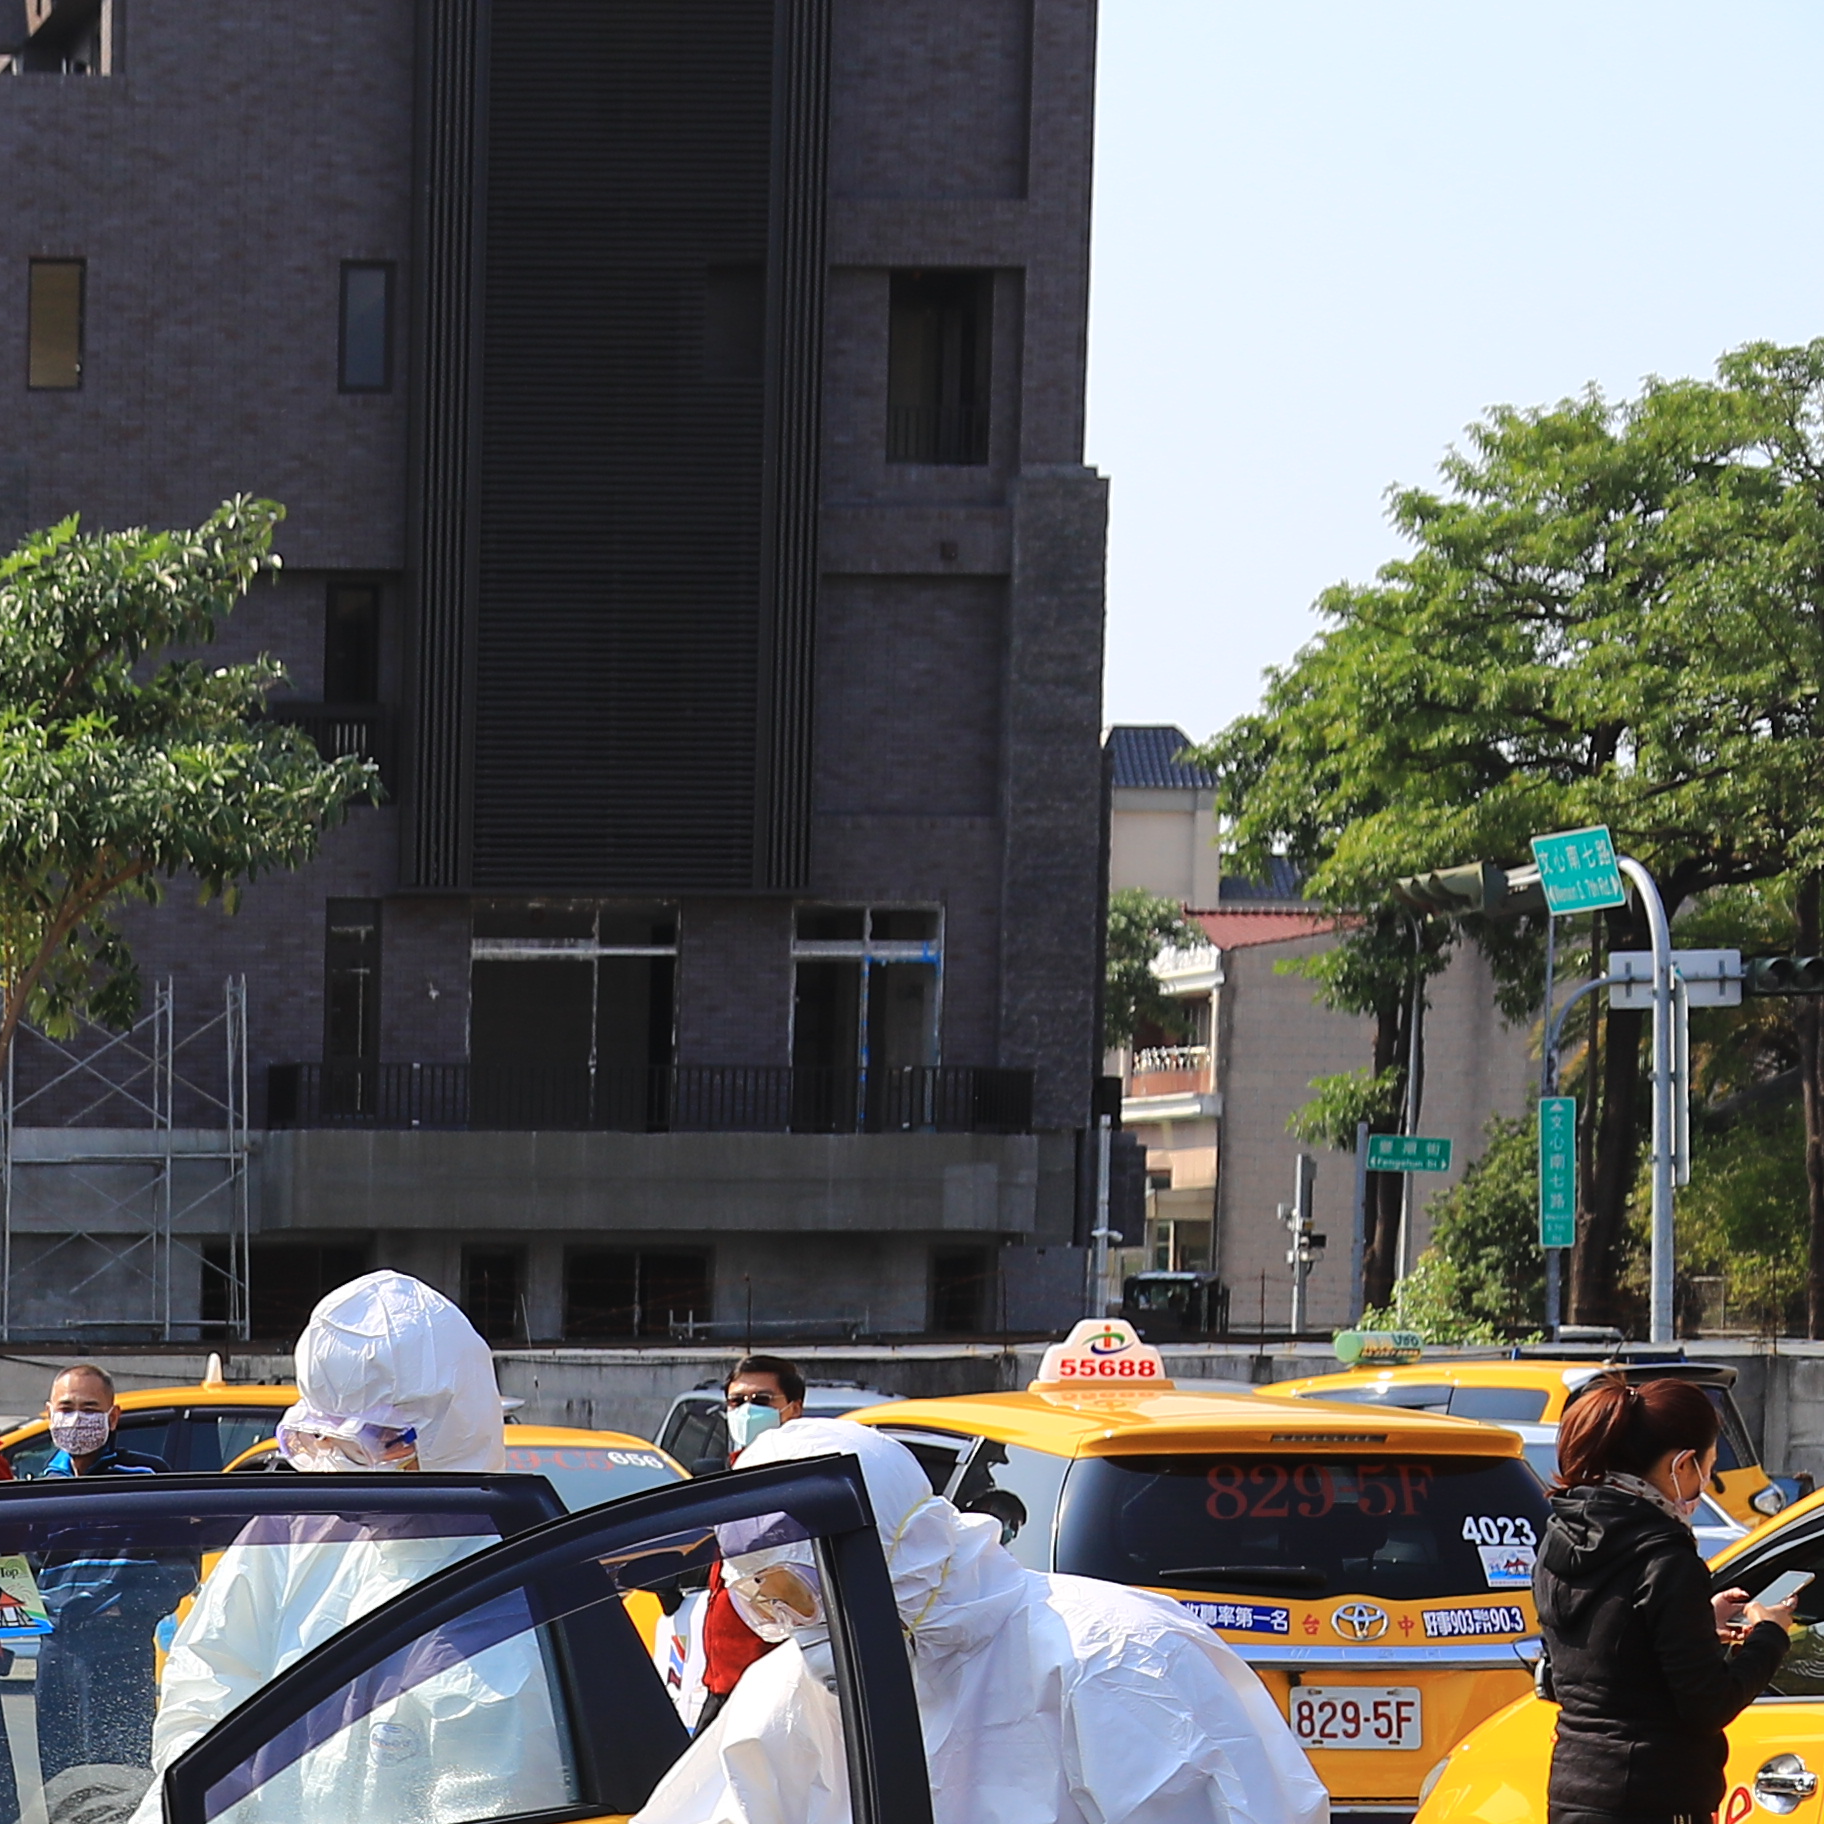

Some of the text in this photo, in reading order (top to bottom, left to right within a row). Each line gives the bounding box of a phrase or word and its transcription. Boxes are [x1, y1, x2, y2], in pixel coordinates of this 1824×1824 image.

[1538, 839, 1612, 875] 文心南七路
[1549, 1114, 1566, 1209] 文心南七路
[1060, 1359, 1156, 1377] 55688
[505, 1450, 665, 1471] 9-C5 656
[1206, 1464, 1433, 1520] 829-5F
[1462, 1516, 1537, 1546] 4023
[1302, 1614, 1415, 1637] 台 中
[1475, 1622, 1492, 1633] FM
[1490, 1607, 1525, 1632] 90.3
[1297, 1700, 1415, 1739] 829-5F
